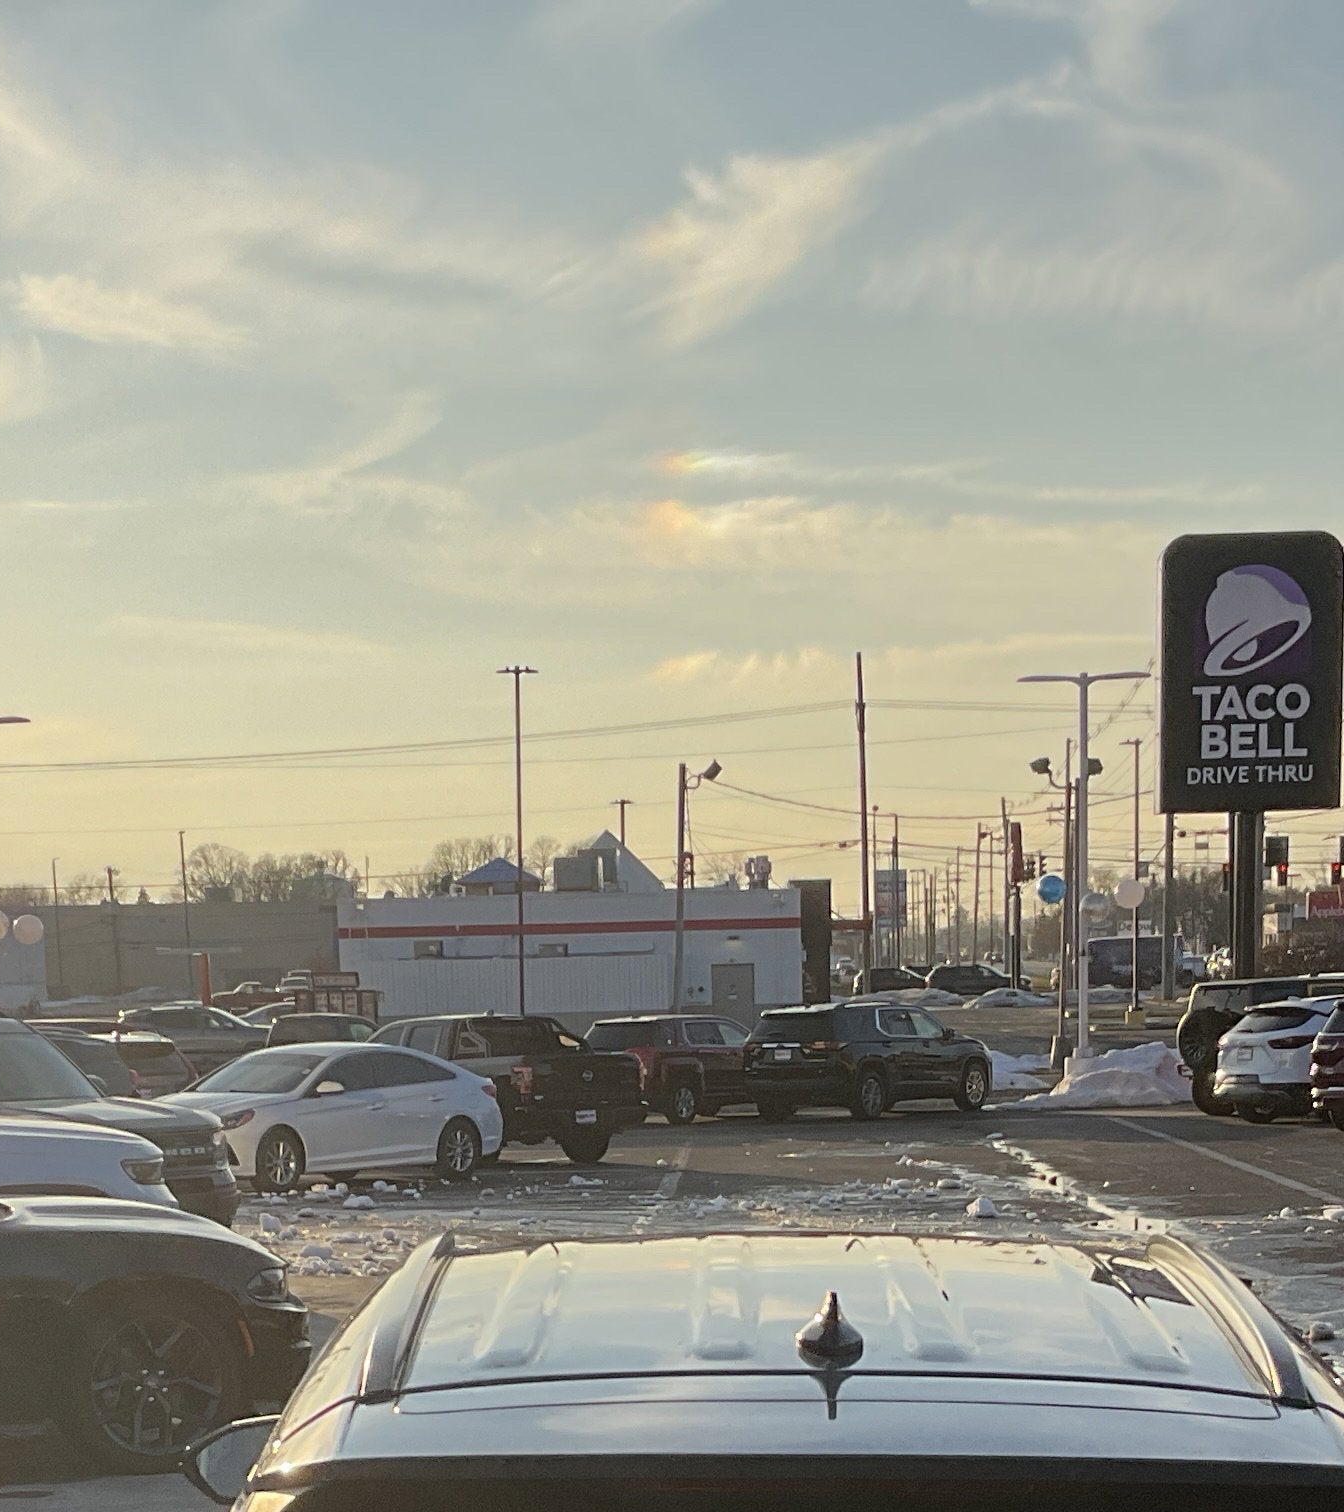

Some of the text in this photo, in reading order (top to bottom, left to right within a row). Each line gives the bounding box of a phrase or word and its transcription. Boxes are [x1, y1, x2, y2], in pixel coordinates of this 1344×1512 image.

[1192, 683, 1311, 721] TACO
[1200, 722, 1308, 760] BELL
[1186, 764, 1314, 785] DRIVE THRU
